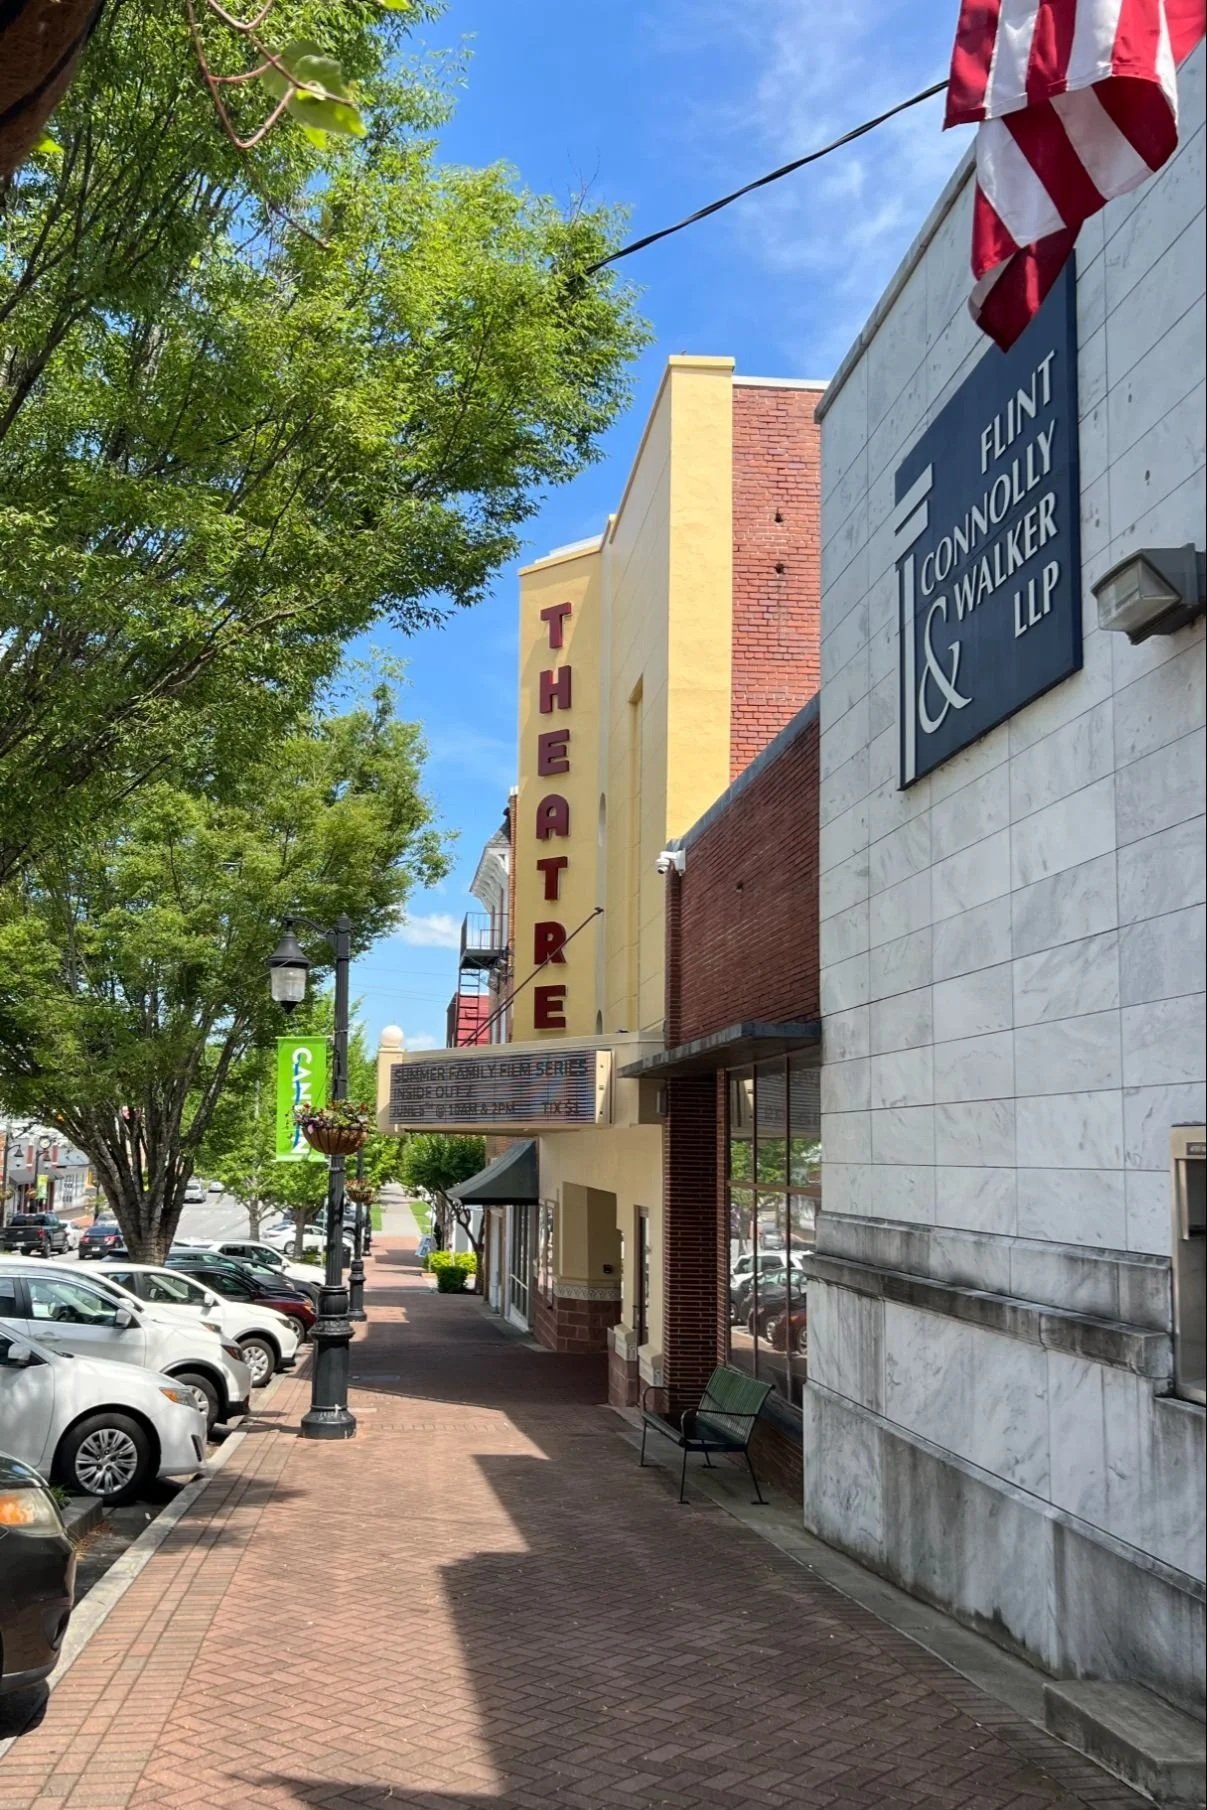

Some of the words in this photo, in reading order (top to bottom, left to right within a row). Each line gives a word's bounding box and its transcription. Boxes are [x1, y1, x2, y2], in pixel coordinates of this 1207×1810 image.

[979, 349, 1056, 475] FLINT
[920, 419, 1057, 597] CONNOLLY
[918, 596, 973, 735] &
[953, 491, 1058, 623] WALKER
[1013, 560, 1061, 640] LLP
[533, 601, 572, 1030] THEATRE
[393, 1065, 446, 1084] SUMMER
[449, 1063, 497, 1080] FAMILY
[499, 1061, 531, 1078] FILM
[535, 1058, 589, 1077] SERIES
[393, 1086, 432, 1100] INSIDE
[435, 1085, 461, 1099] OUT
[541, 1100, 562, 1116] TIX
